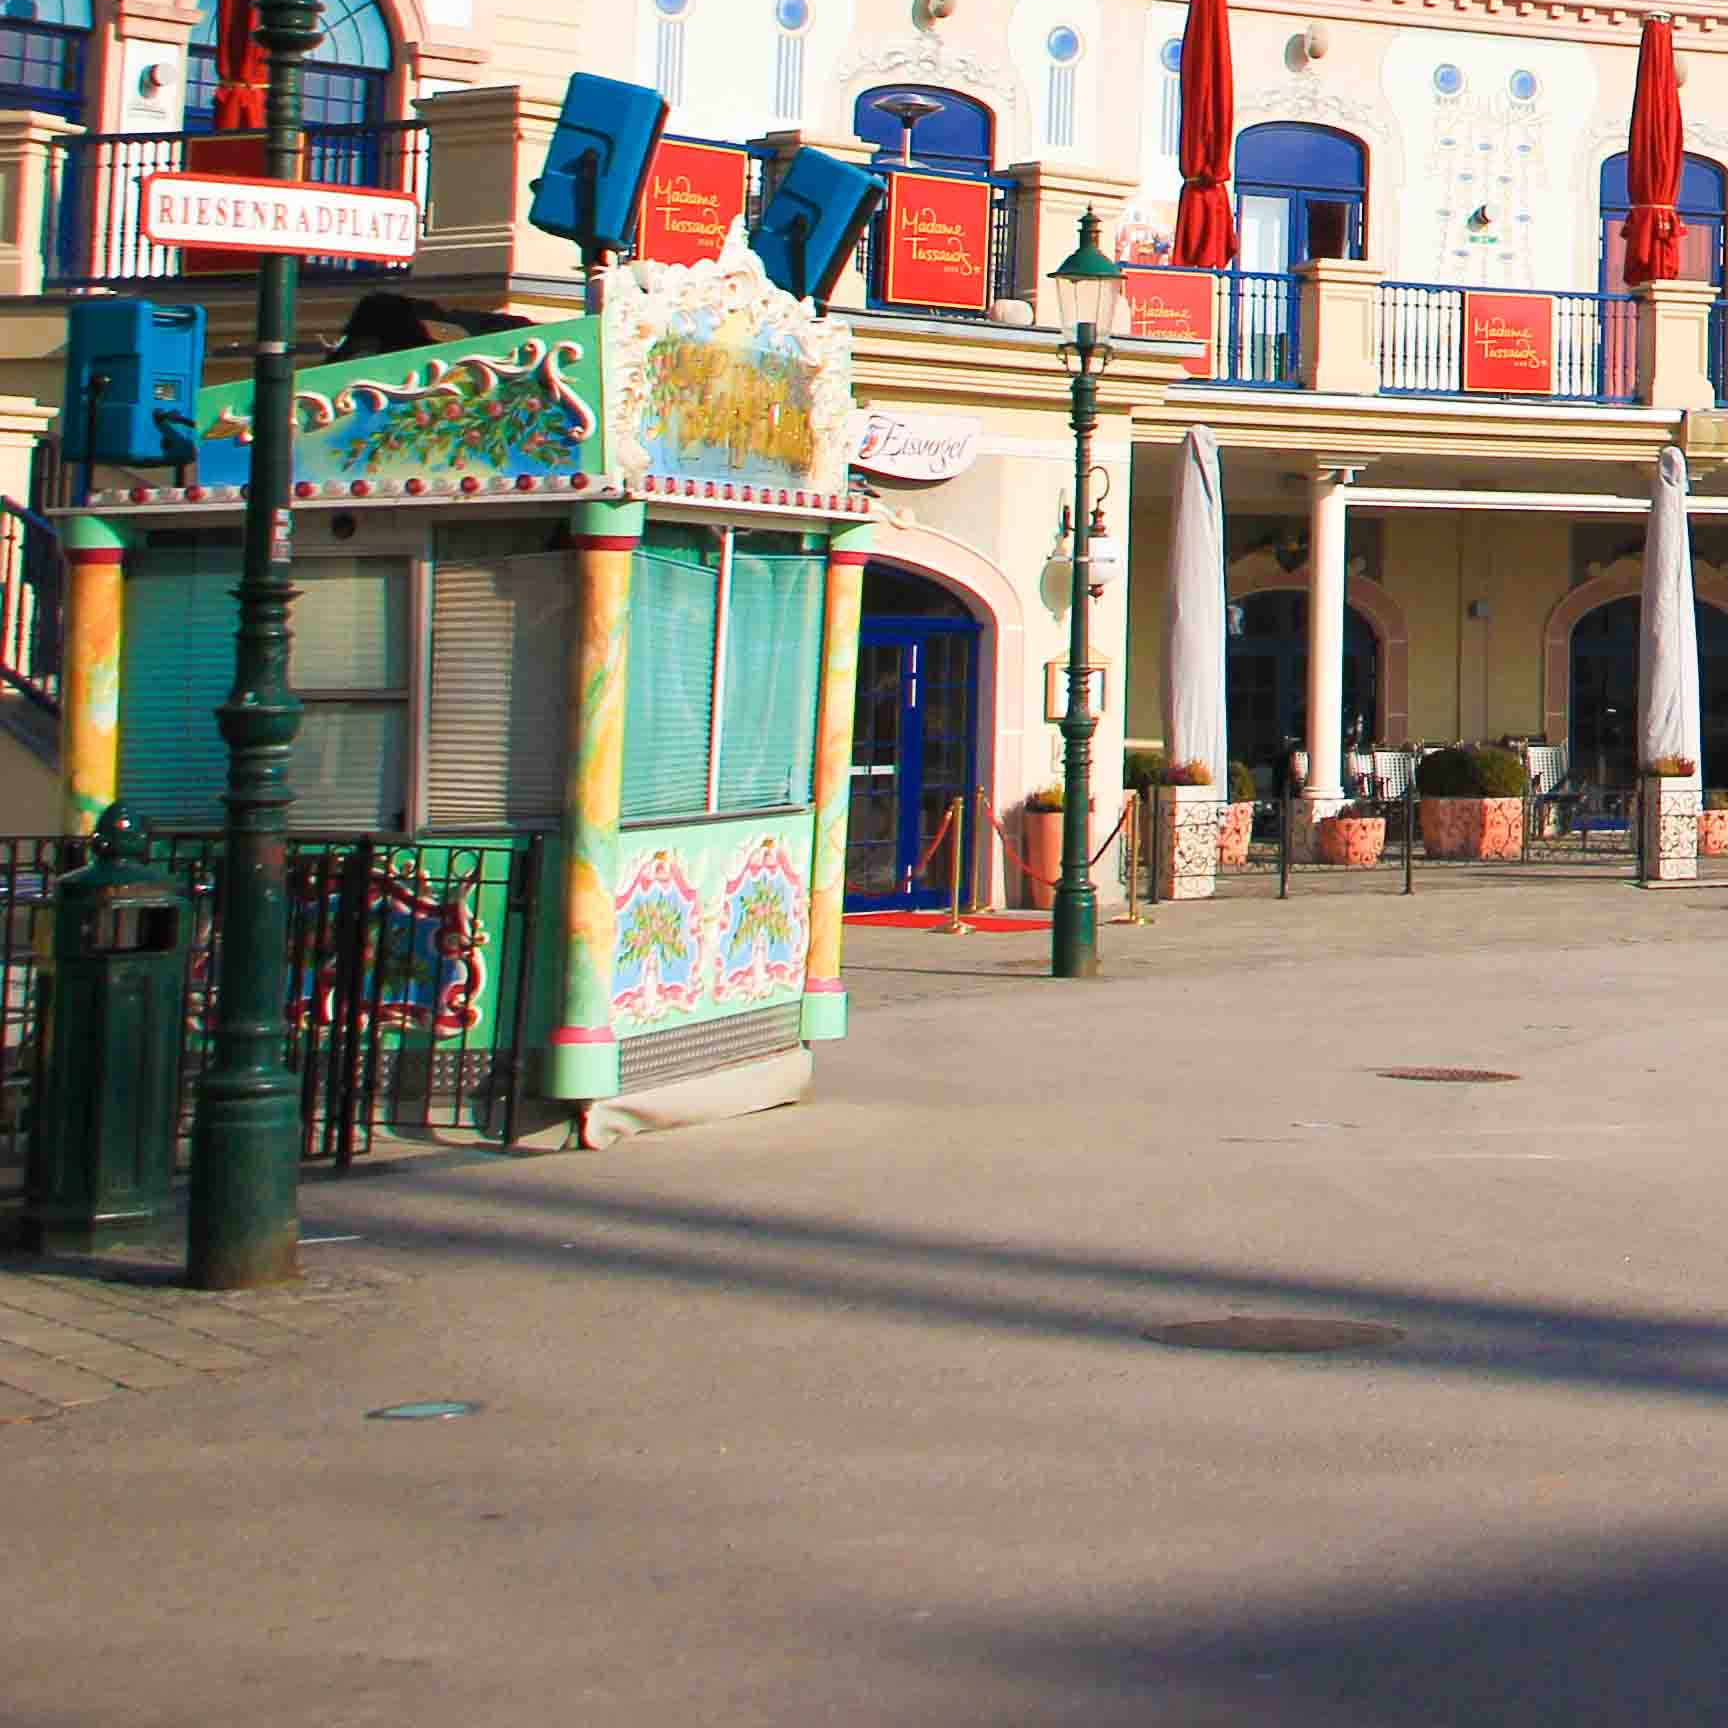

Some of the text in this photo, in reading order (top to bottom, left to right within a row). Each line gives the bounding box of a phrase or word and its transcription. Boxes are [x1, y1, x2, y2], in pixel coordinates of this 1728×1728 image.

[653, 175, 721, 209] Madame
[158, 193, 412, 241] RIESENRADPLATZ
[901, 207, 967, 238] Madame
[902, 236, 972, 277] Tussauds
[1131, 296, 1192, 322] Madame
[1473, 316, 1534, 340] Madame
[1473, 339, 1541, 368] Tussauds
[868, 414, 975, 473] Eisvogel
